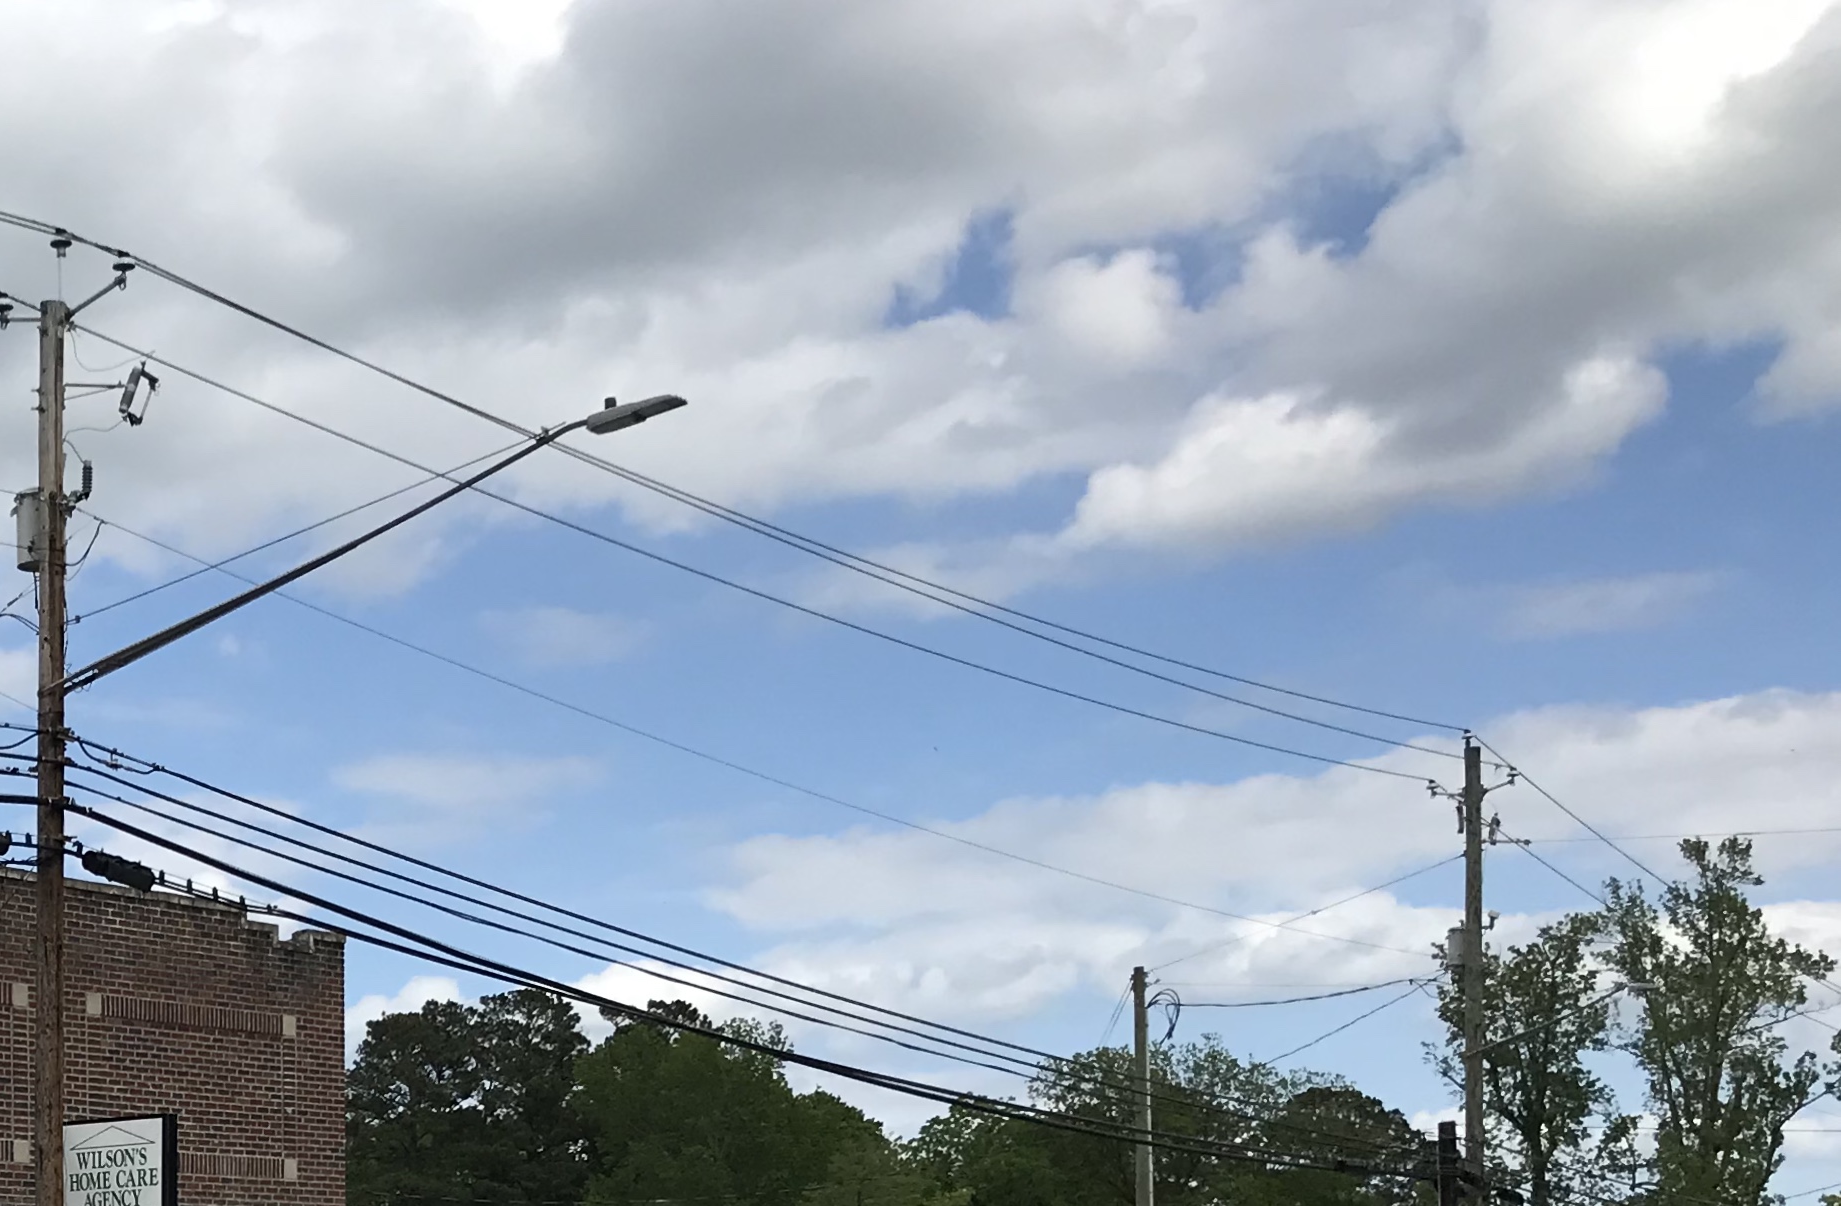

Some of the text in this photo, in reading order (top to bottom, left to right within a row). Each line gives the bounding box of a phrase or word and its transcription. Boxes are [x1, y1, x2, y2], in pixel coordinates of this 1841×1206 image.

[76, 1147, 147, 1170] WILSON'S
[69, 1168, 159, 1192] HOME CARE
